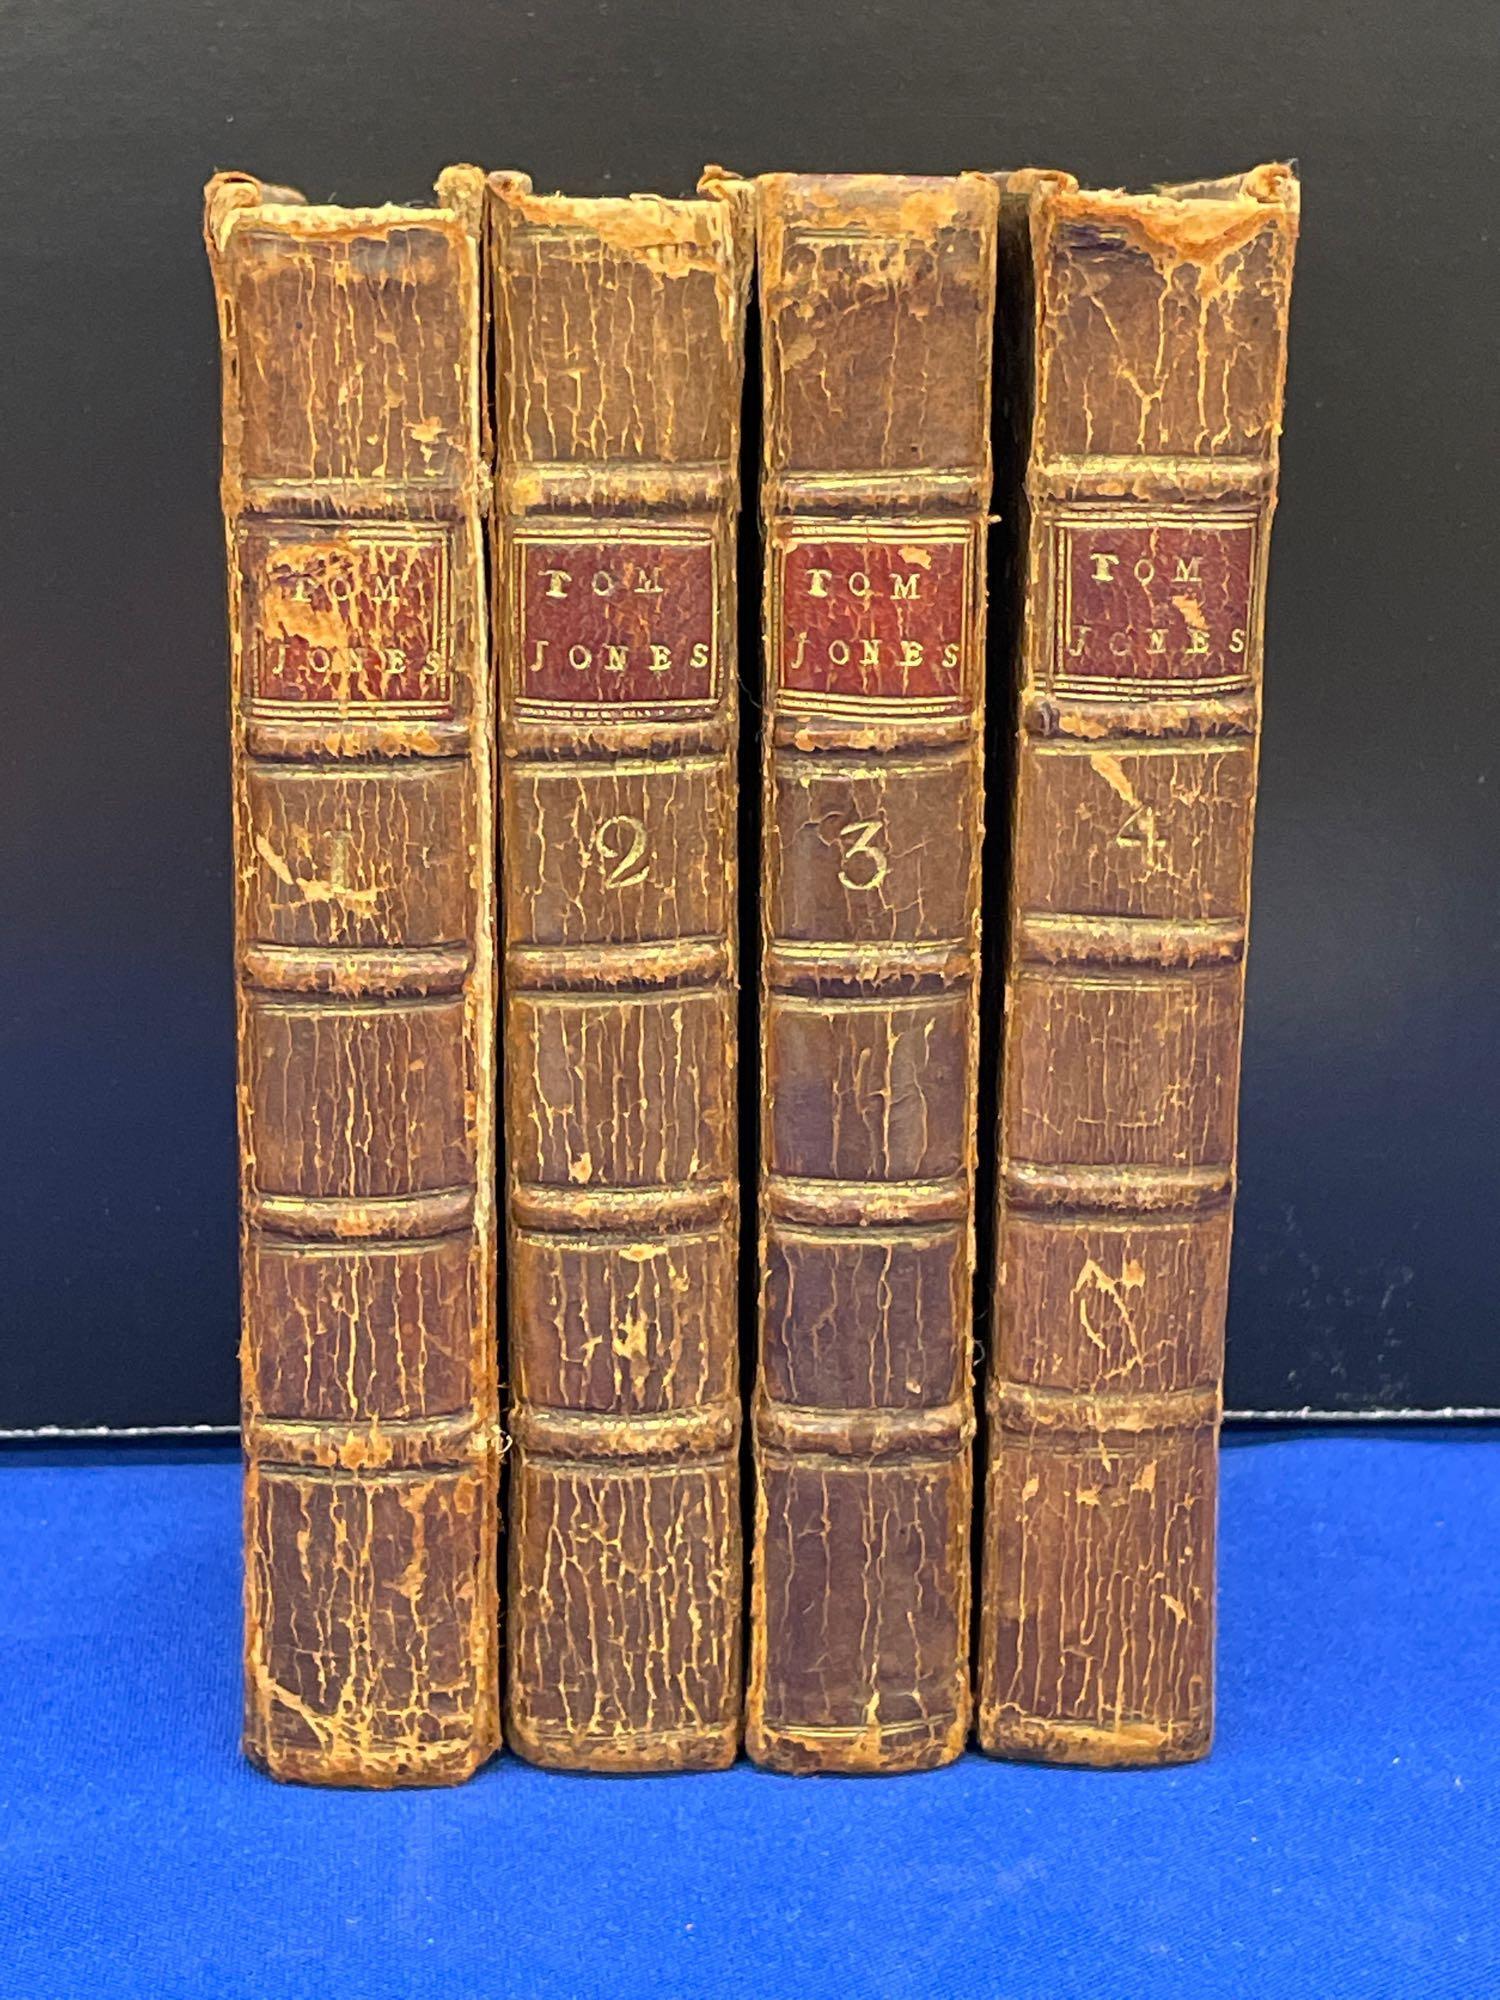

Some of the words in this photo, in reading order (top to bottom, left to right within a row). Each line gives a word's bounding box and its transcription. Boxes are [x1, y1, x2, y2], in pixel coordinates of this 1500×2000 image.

[538, 567, 666, 598] TOM
[1090, 553, 1203, 583] TOM
[806, 568, 921, 600] TOM
[530, 641, 710, 672] JONES
[791, 632, 961, 669] JONES
[1068, 626, 1246, 657] JONES
[272, 647, 443, 675] JONES
[596, 815, 650, 889] 2
[1116, 806, 1167, 867] 4
[838, 820, 888, 890] 3
